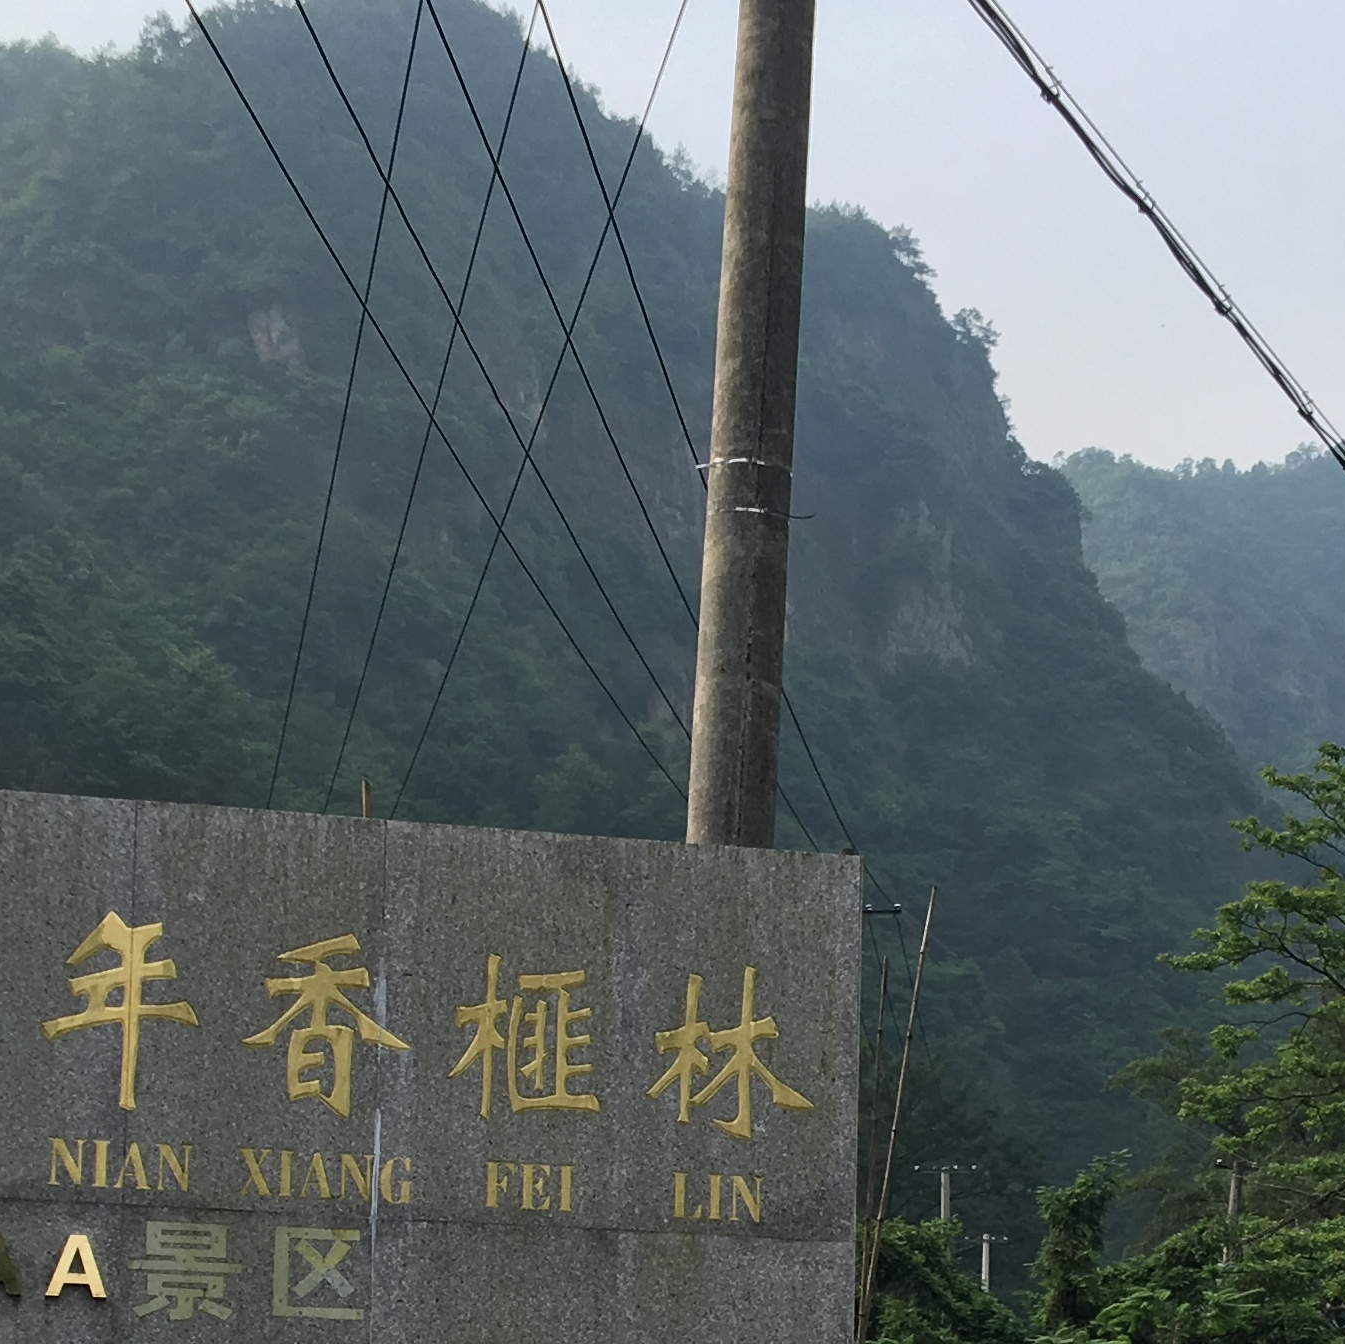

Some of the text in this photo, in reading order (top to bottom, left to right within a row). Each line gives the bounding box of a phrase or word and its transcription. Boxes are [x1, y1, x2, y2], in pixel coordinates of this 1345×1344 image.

[48, 1137, 194, 1194] NIAN
[240, 1147, 414, 1206] XIANG
[485, 1160, 575, 1214] FEI
[672, 1172, 764, 1225] LIN
